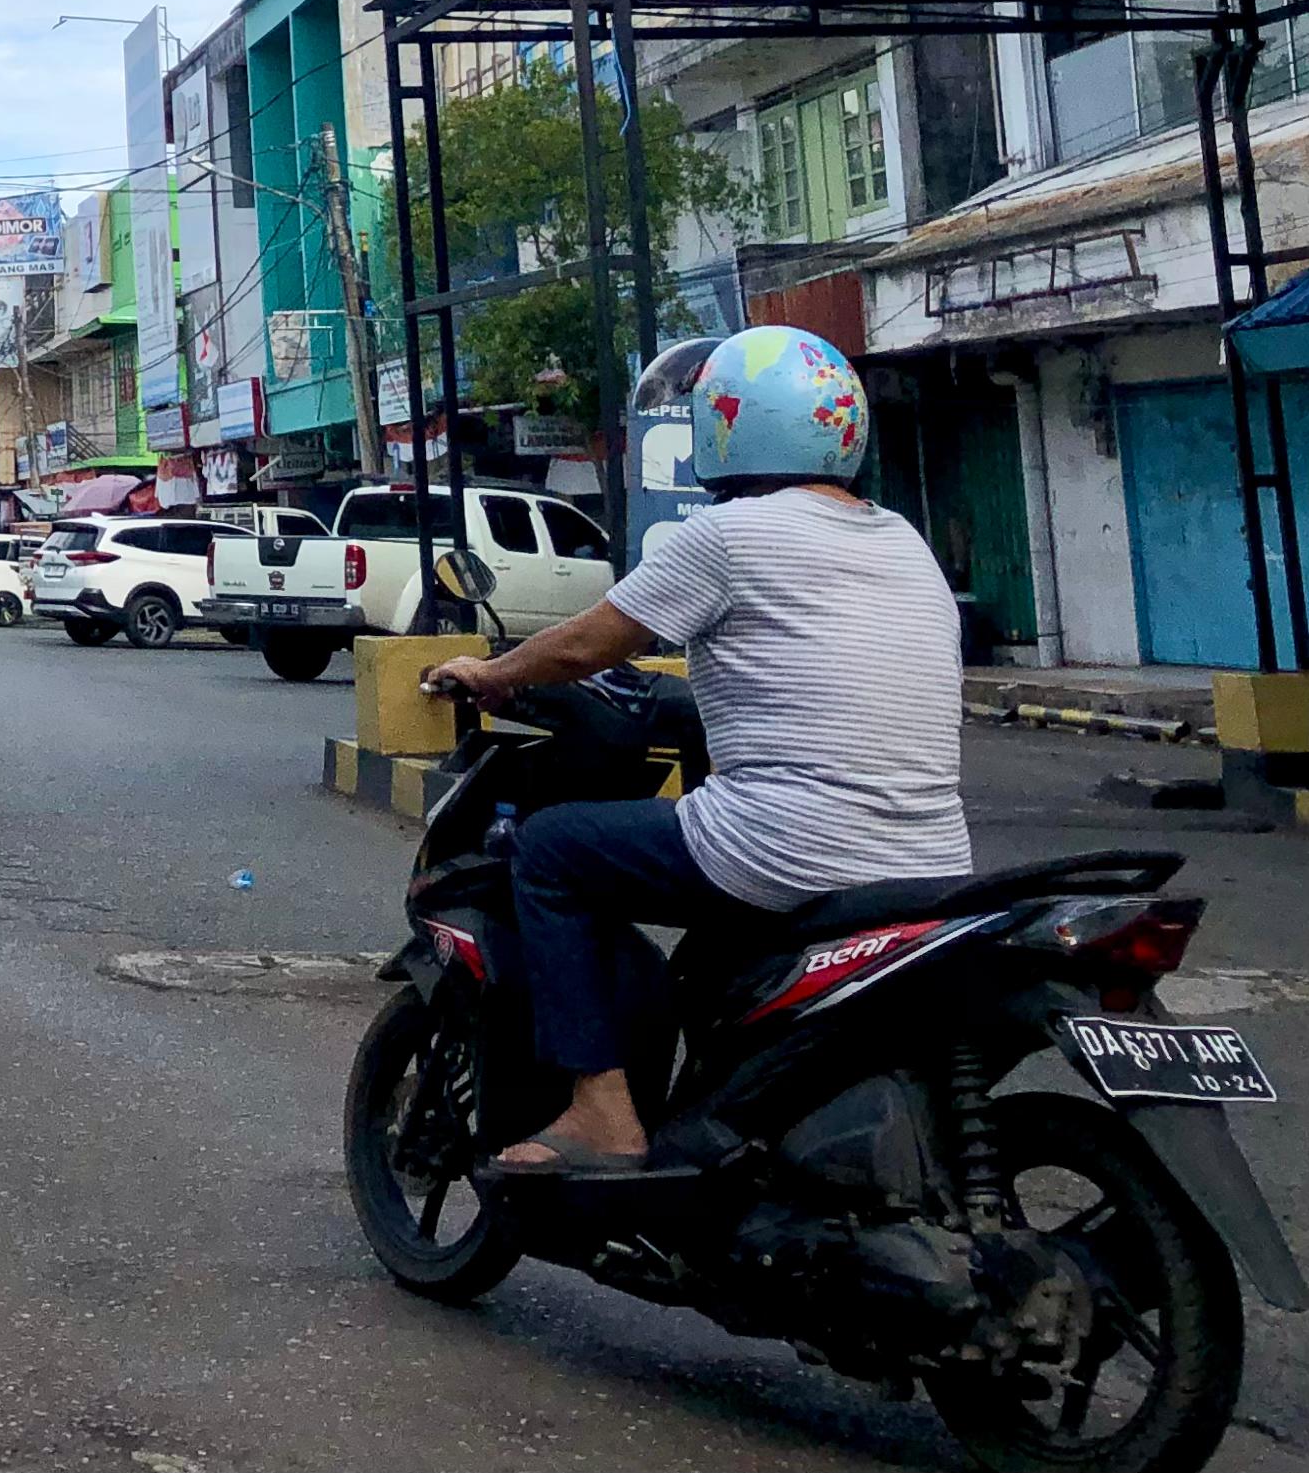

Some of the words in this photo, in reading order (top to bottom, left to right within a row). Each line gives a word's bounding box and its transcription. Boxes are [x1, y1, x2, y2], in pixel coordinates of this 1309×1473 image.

[28, 263, 55, 273] MAS
[1077, 1025, 1126, 1057] DA
[1191, 1034, 1243, 1064] AHF
